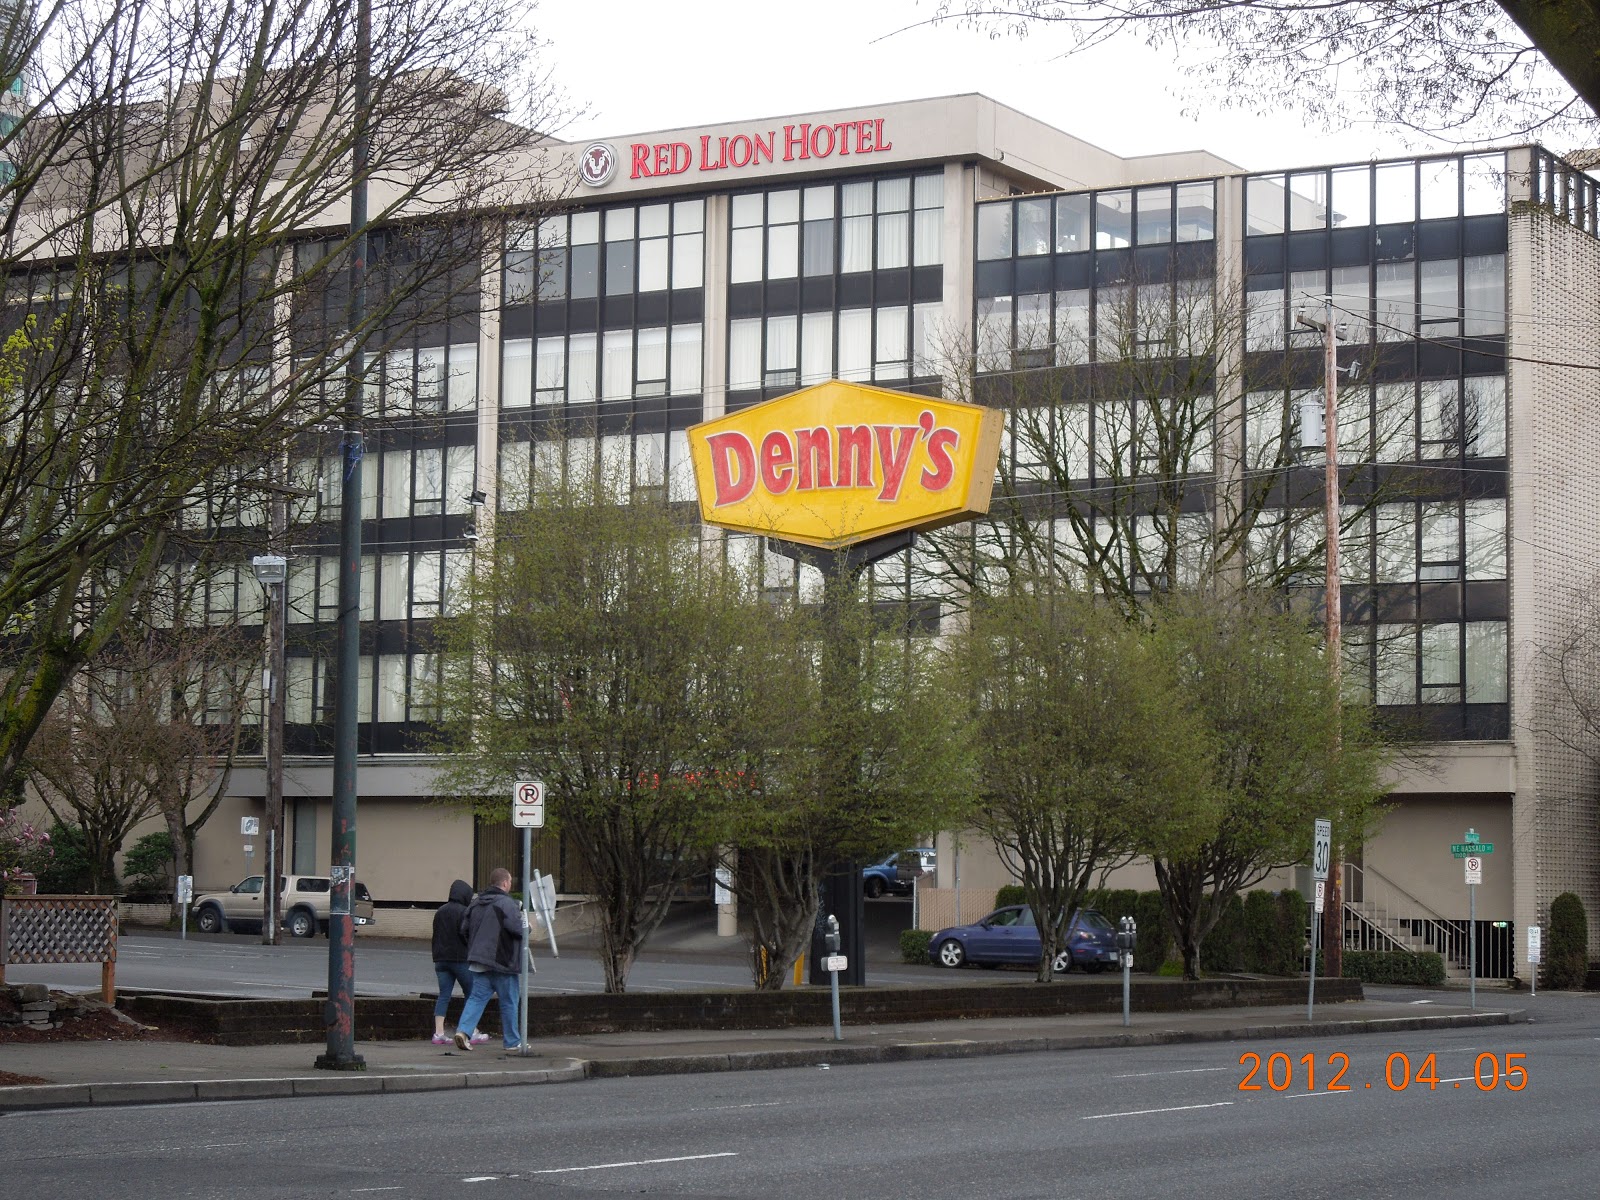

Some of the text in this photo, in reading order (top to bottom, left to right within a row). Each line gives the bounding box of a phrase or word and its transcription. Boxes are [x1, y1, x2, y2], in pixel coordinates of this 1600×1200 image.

[630, 118, 893, 179] RED LION HOTEL
[705, 410, 960, 508] Denny's
[1317, 825, 1330, 837] SPEED
[1315, 840, 1329, 873] 30
